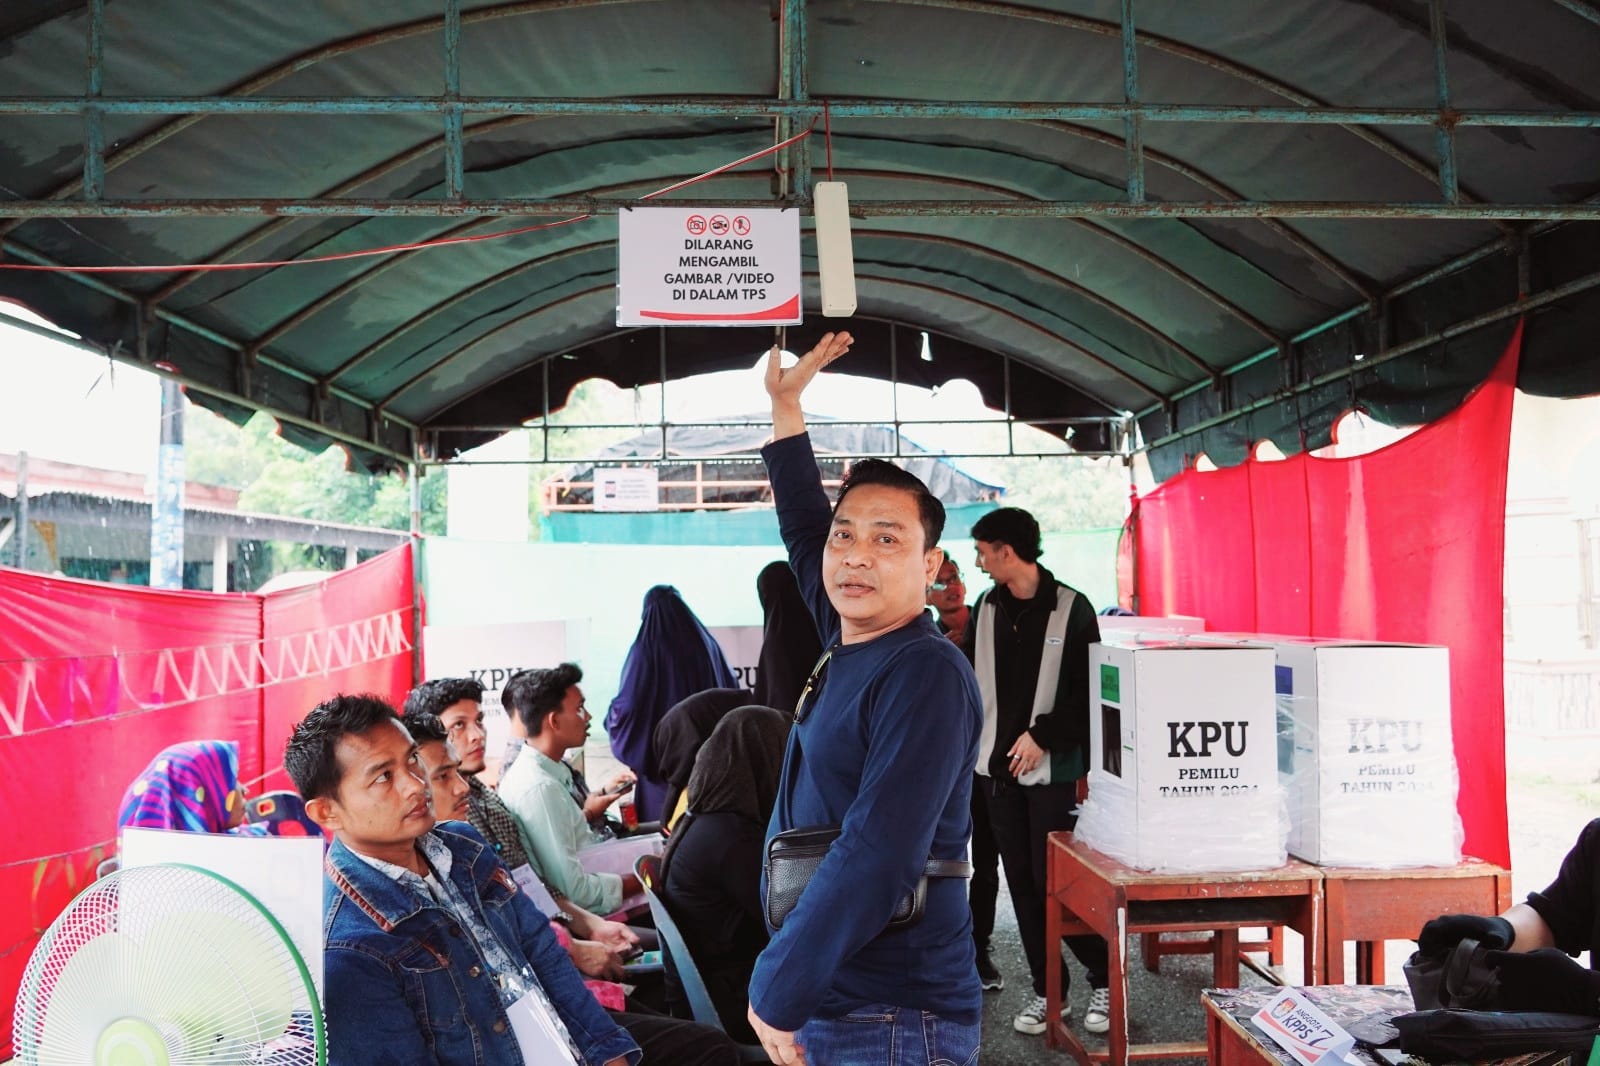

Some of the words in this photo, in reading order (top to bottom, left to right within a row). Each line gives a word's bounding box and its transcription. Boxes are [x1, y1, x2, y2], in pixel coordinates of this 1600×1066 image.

[684, 239, 753, 250] DILARANG
[679, 256, 759, 267] MENGAMBIL
[664, 272, 722, 284] GAMBAR
[727, 272, 775, 285] /VIDEO
[673, 289, 686, 300] DI
[689, 289, 738, 300] DALAM
[741, 288, 767, 300] TPS
[733, 666, 759, 689] PU
[1167, 720, 1249, 758] KPU
[1347, 718, 1423, 754] KPU
[1178, 767, 1240, 780] PEMILU
[1159, 785, 1216, 798] TAHUN
[1340, 781, 1393, 794] TAHUN
[1296, 1008, 1323, 1031] ANGGOTA
[1282, 1014, 1314, 1040] KPPS
[1308, 1028, 1335, 1047] 7
